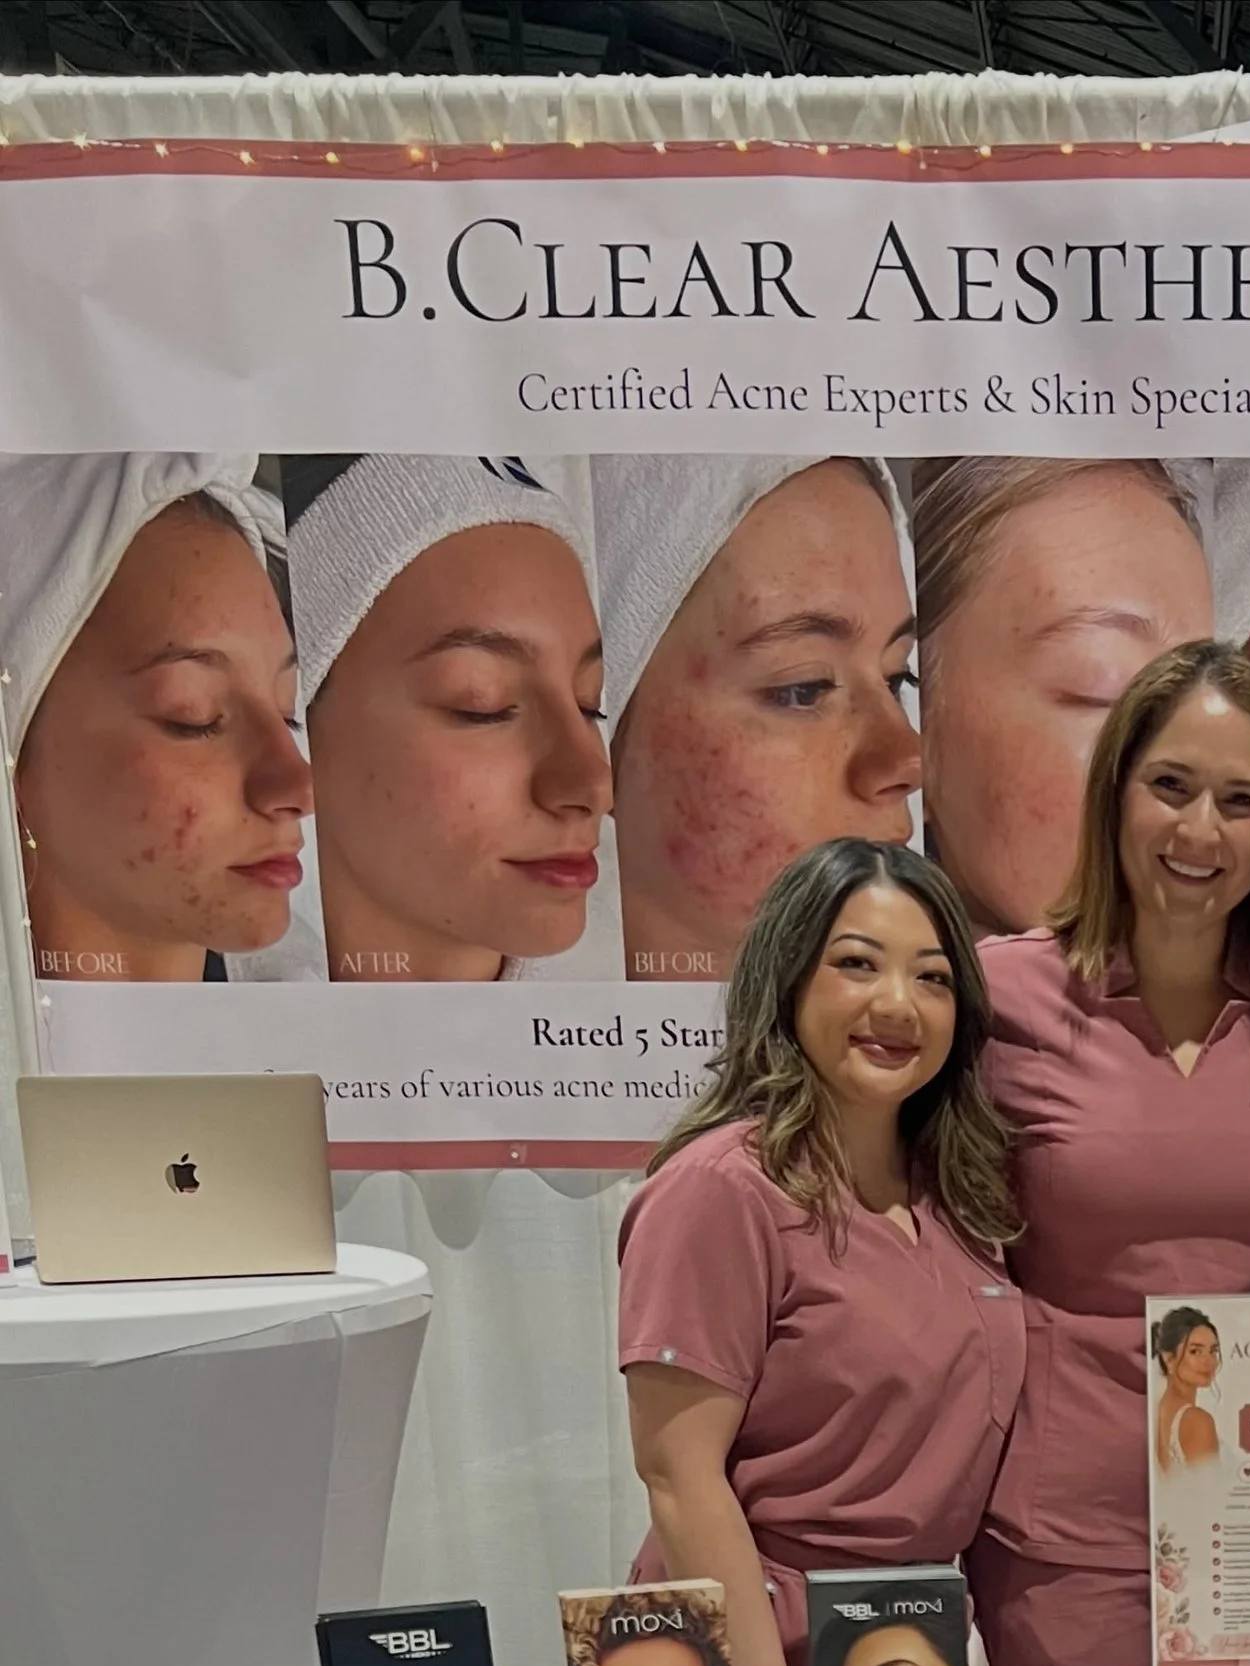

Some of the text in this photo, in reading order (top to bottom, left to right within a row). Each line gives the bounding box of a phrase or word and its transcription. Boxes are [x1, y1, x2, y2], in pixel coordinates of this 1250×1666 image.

[334, 217, 816, 322] B.CLEAR
[518, 368, 693, 413] Certified
[706, 374, 809, 413] Acne
[823, 374, 968, 428] Experts
[983, 376, 1013, 414] &
[1031, 373, 1115, 416] Skin
[40, 950, 130, 974] BEFORE
[339, 951, 411, 973] AFTER
[634, 951, 720, 974] BEFORE
[531, 1015, 624, 1046] Rated
[635, 1028, 649, 1057] 5
[401, 1069, 434, 1098] of
[438, 1073, 543, 1099] various
[553, 1079, 614, 1098] acne
[624, 1070, 713, 1099] medic
[611, 1608, 683, 1635] moxi
[843, 1603, 880, 1617] BBL
[387, 1628, 454, 1655] BBL
